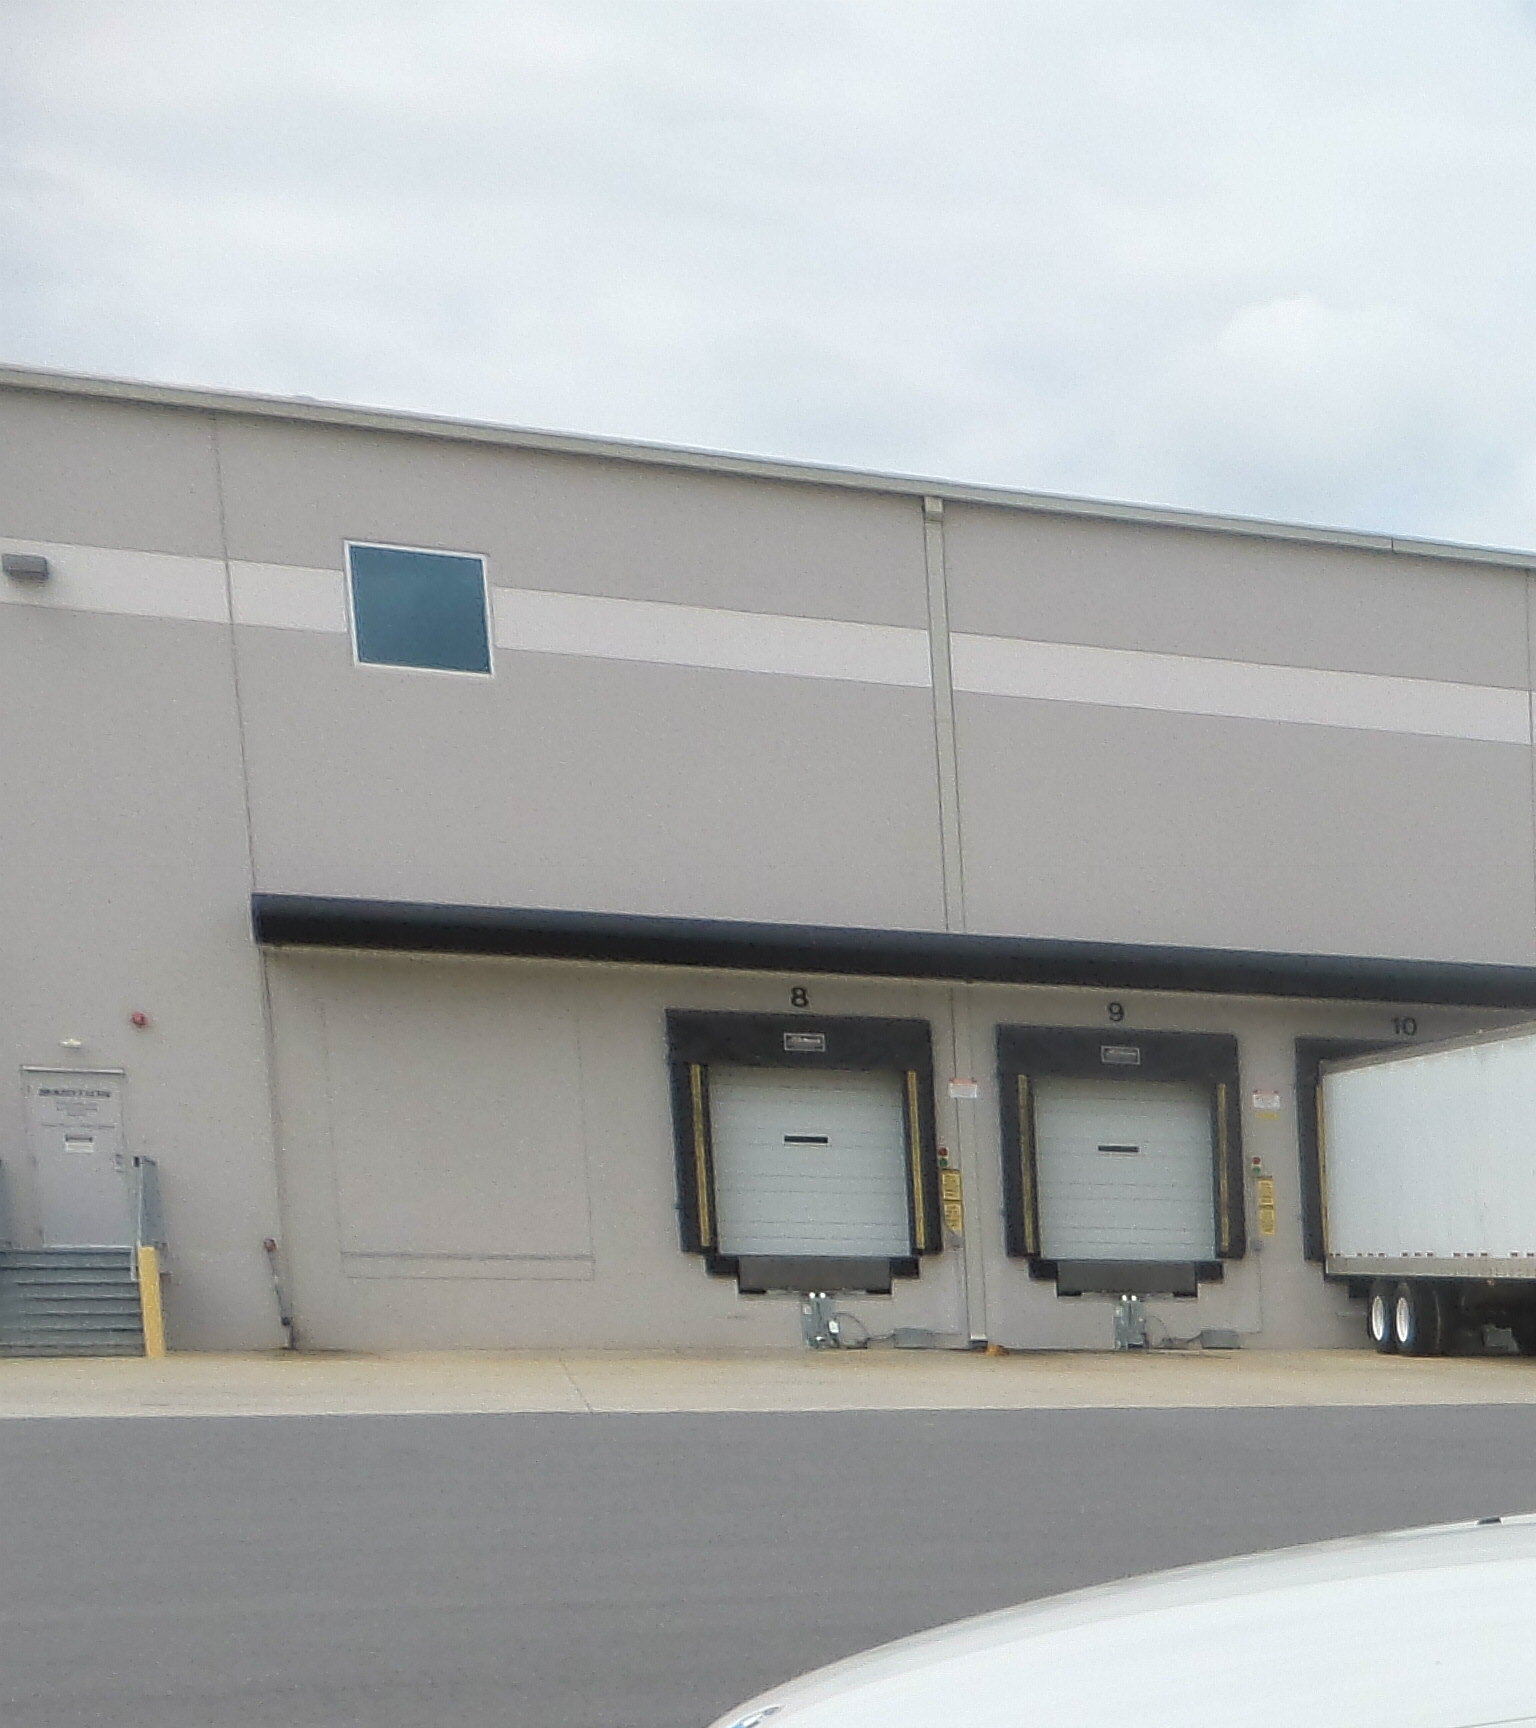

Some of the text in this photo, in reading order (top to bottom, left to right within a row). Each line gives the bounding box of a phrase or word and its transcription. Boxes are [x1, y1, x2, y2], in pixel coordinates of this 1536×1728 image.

[791, 987, 808, 1007] 8
[1109, 1002, 1124, 1022] 9
[1392, 1016, 1418, 1036] 10
